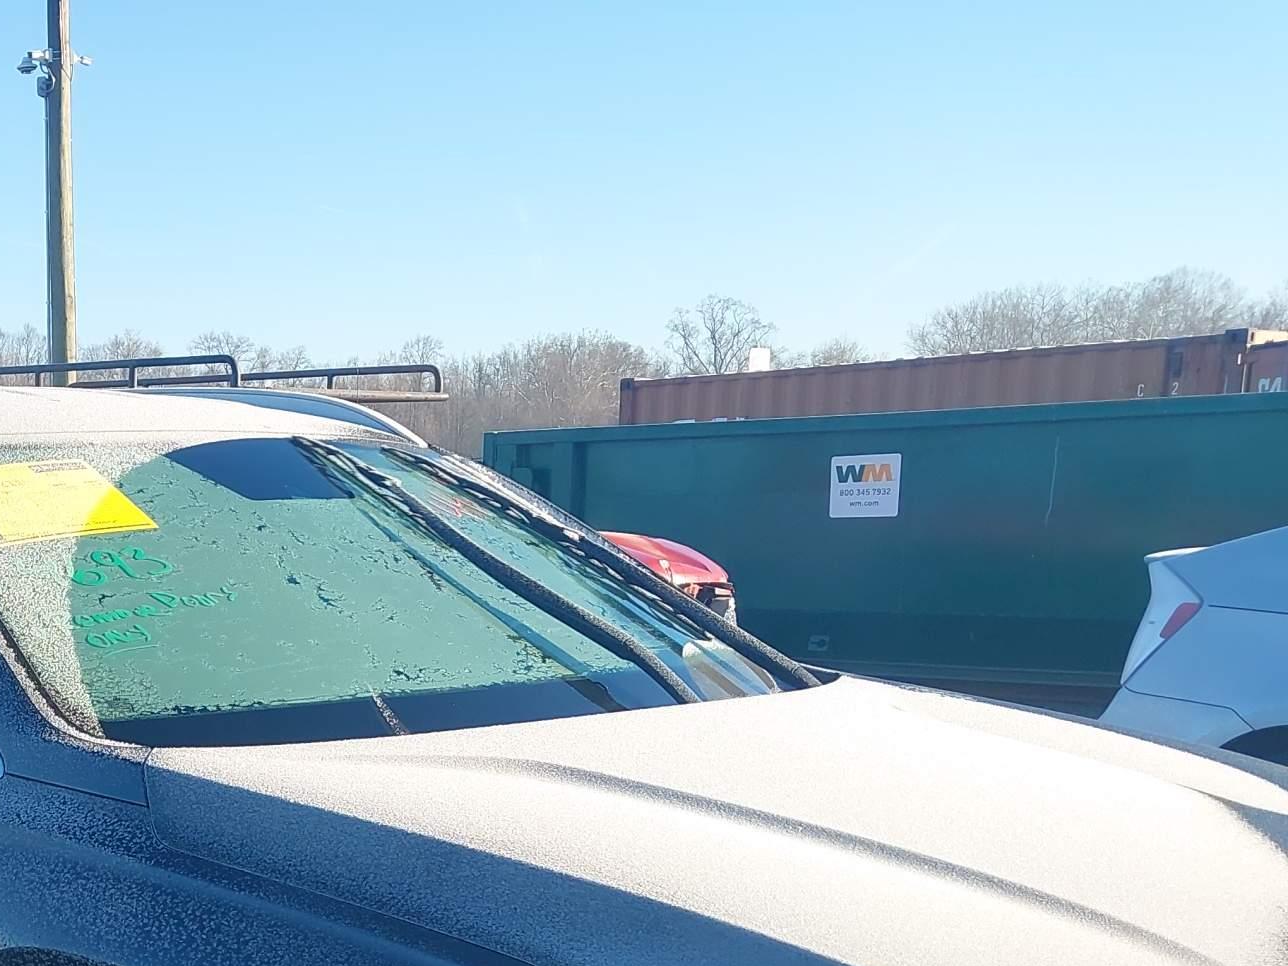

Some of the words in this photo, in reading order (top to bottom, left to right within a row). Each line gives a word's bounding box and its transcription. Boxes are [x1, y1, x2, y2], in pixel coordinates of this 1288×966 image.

[836, 463, 893, 483] WM
[840, 489, 854, 497] 800
[856, 488, 870, 496] 345
[872, 487, 892, 496] 7932
